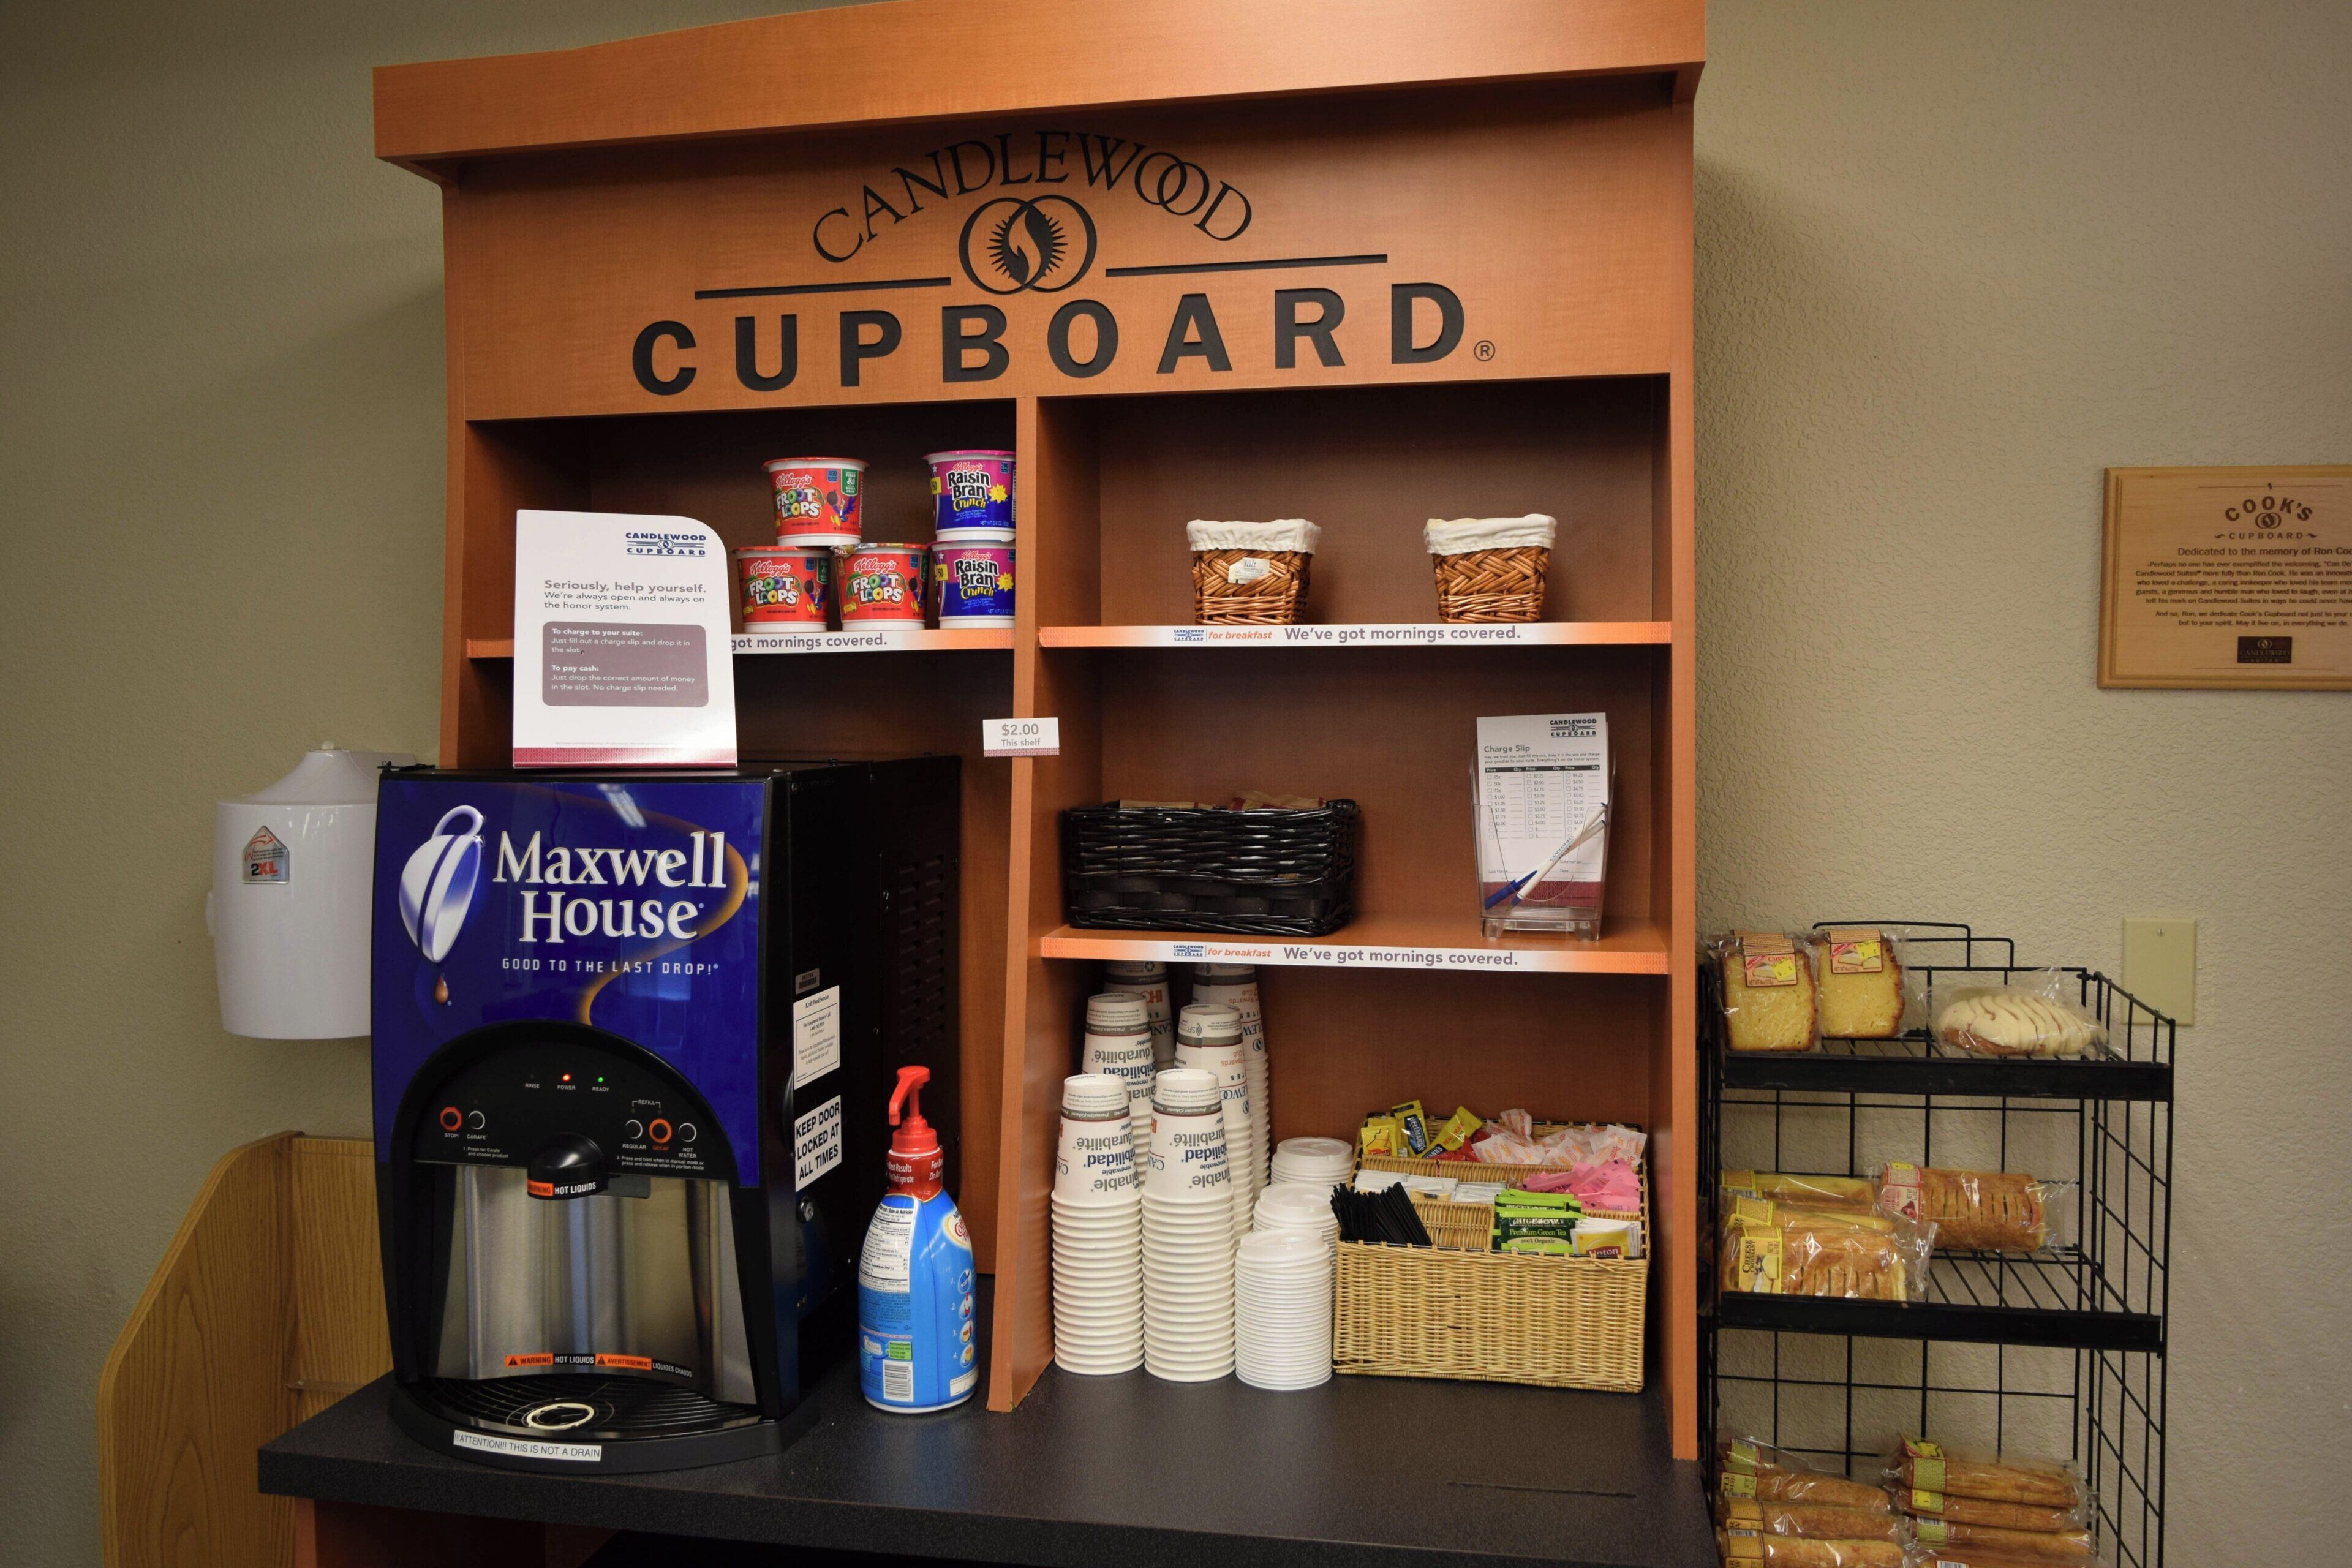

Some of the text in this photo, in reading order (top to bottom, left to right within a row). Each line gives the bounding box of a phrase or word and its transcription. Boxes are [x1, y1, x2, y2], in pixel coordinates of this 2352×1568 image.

[813, 130, 1252, 264] CANDLEWOOD
[632, 282, 1465, 395] CUPBOARD
[952, 462, 982, 472] Kellogg's
[776, 473, 812, 489] Kellogg's
[948, 472, 990, 487] Raisin
[777, 489, 815, 510] FROOT
[953, 485, 986, 499] Bran
[782, 502, 820, 518] LOOPS
[953, 498, 986, 511] Crunch
[2225, 496, 2312, 521] COOK'S
[625, 532, 706, 541] CANDLEWOOD
[962, 550, 991, 560] Kellogg's
[750, 560, 791, 576] Kellogg's
[854, 557, 896, 574] Kellogg's
[955, 560, 998, 576] Raisin
[545, 580, 706, 594] Seriously, help yourself.
[749, 577, 793, 596] FROOT
[853, 574, 899, 594] FROOT
[960, 573, 994, 587] Bran
[756, 590, 797, 605] LOOPS
[860, 587, 902, 601] LOOPS
[961, 587, 993, 600] Crunch
[1208, 625, 1521, 643] for breakfast We've got mornings covered.
[731, 633, 887, 652] got mornings covered.
[1001, 723, 1039, 736] $2.00
[493, 831, 726, 888] Maxwell
[251, 861, 278, 876] 2XL
[519, 891, 699, 943] House
[1224, 948, 1272, 957] breakfast
[1283, 947, 1332, 960] We've
[1337, 949, 1364, 963] got
[1370, 950, 1442, 966] mornings
[1449, 952, 1518, 965] covered.
[502, 958, 712, 975] GOOD TO THE LAST DROP!
[796, 1102, 840, 1139] KEEP DOOR
[797, 1122, 839, 1161] LOCKED AT
[1409, 1117, 1426, 1152] HELLMANN'S
[799, 1144, 838, 1181] ALL TIMES
[1102, 1166, 1132, 1175] renewable
[555, 1181, 596, 1194] HOT LIQUIDS
[520, 1356, 551, 1365] WARNING
[607, 1358, 651, 1367] AVERTISSEMENT
[652, 1363, 674, 1373] LIQUIDES
[675, 1367, 692, 1378] CHAUDS
[455, 1433, 600, 1457] !!!ATTENTION!!! THIS IS NOT A DRAIN
